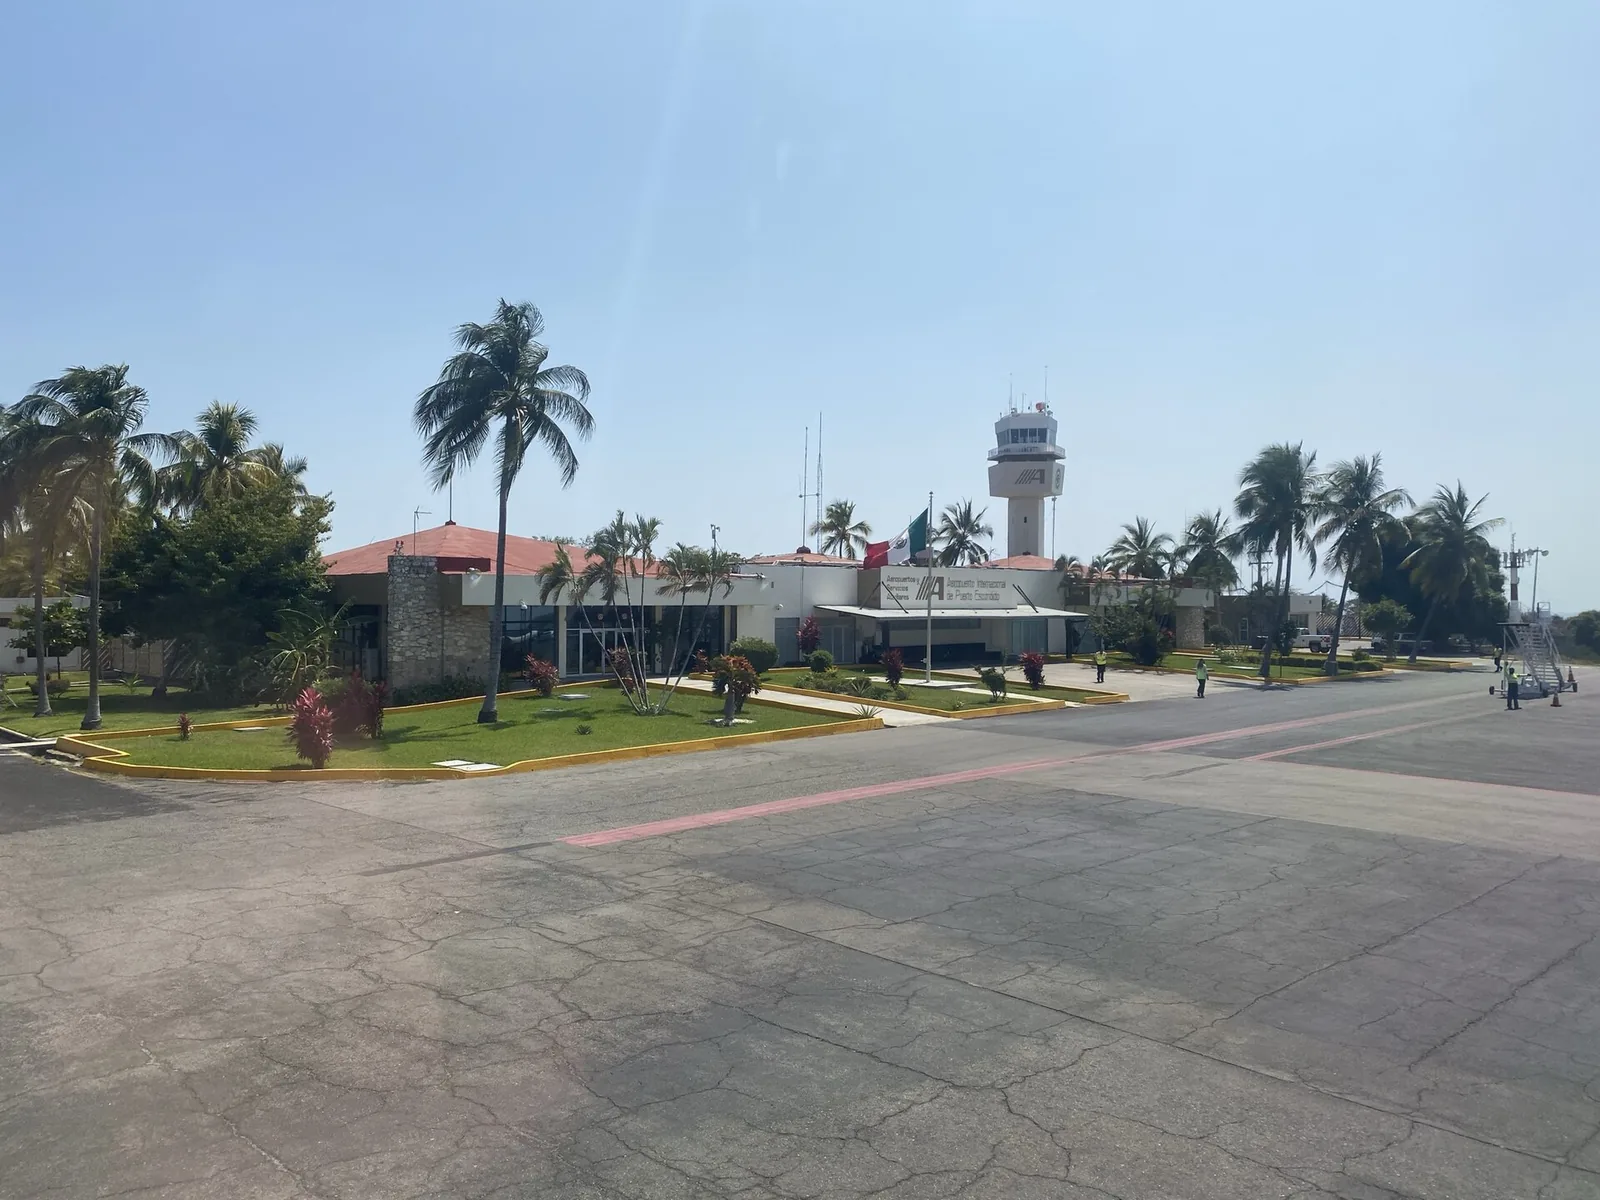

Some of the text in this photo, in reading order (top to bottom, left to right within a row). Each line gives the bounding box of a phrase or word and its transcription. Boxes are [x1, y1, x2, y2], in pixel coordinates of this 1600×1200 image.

[886, 575, 916, 583] Aeropuertos
[946, 577, 1007, 589] Aeropuerto Internacional
[886, 584, 909, 592] Servicios
[946, 590, 1001, 601] de Puerto Escondido
